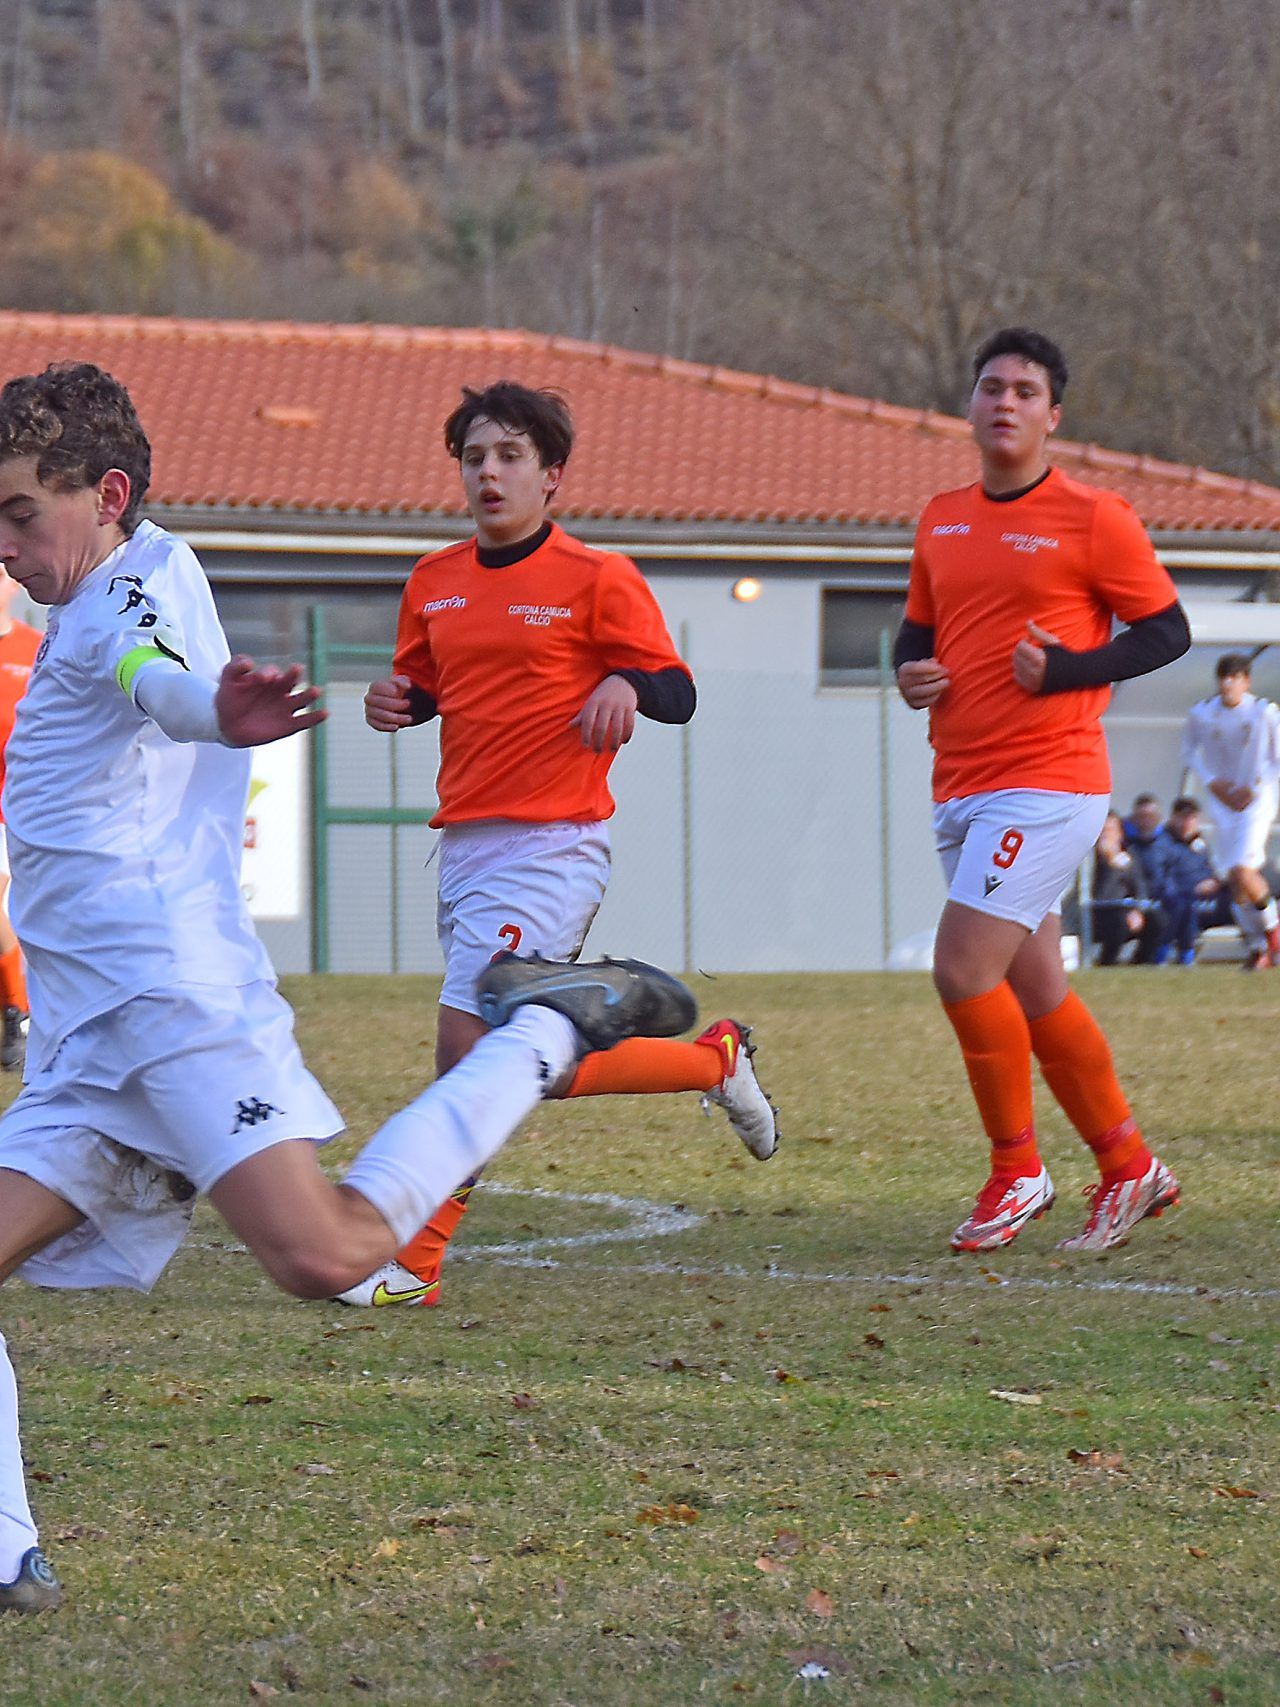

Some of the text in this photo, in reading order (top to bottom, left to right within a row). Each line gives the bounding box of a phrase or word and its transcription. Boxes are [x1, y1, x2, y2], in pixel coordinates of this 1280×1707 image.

[423, 595, 466, 613] macron
[508, 604, 572, 618] CORTONA CAMUCIA
[524, 614, 551, 626] CALCIO
[992, 828, 1024, 870] 9
